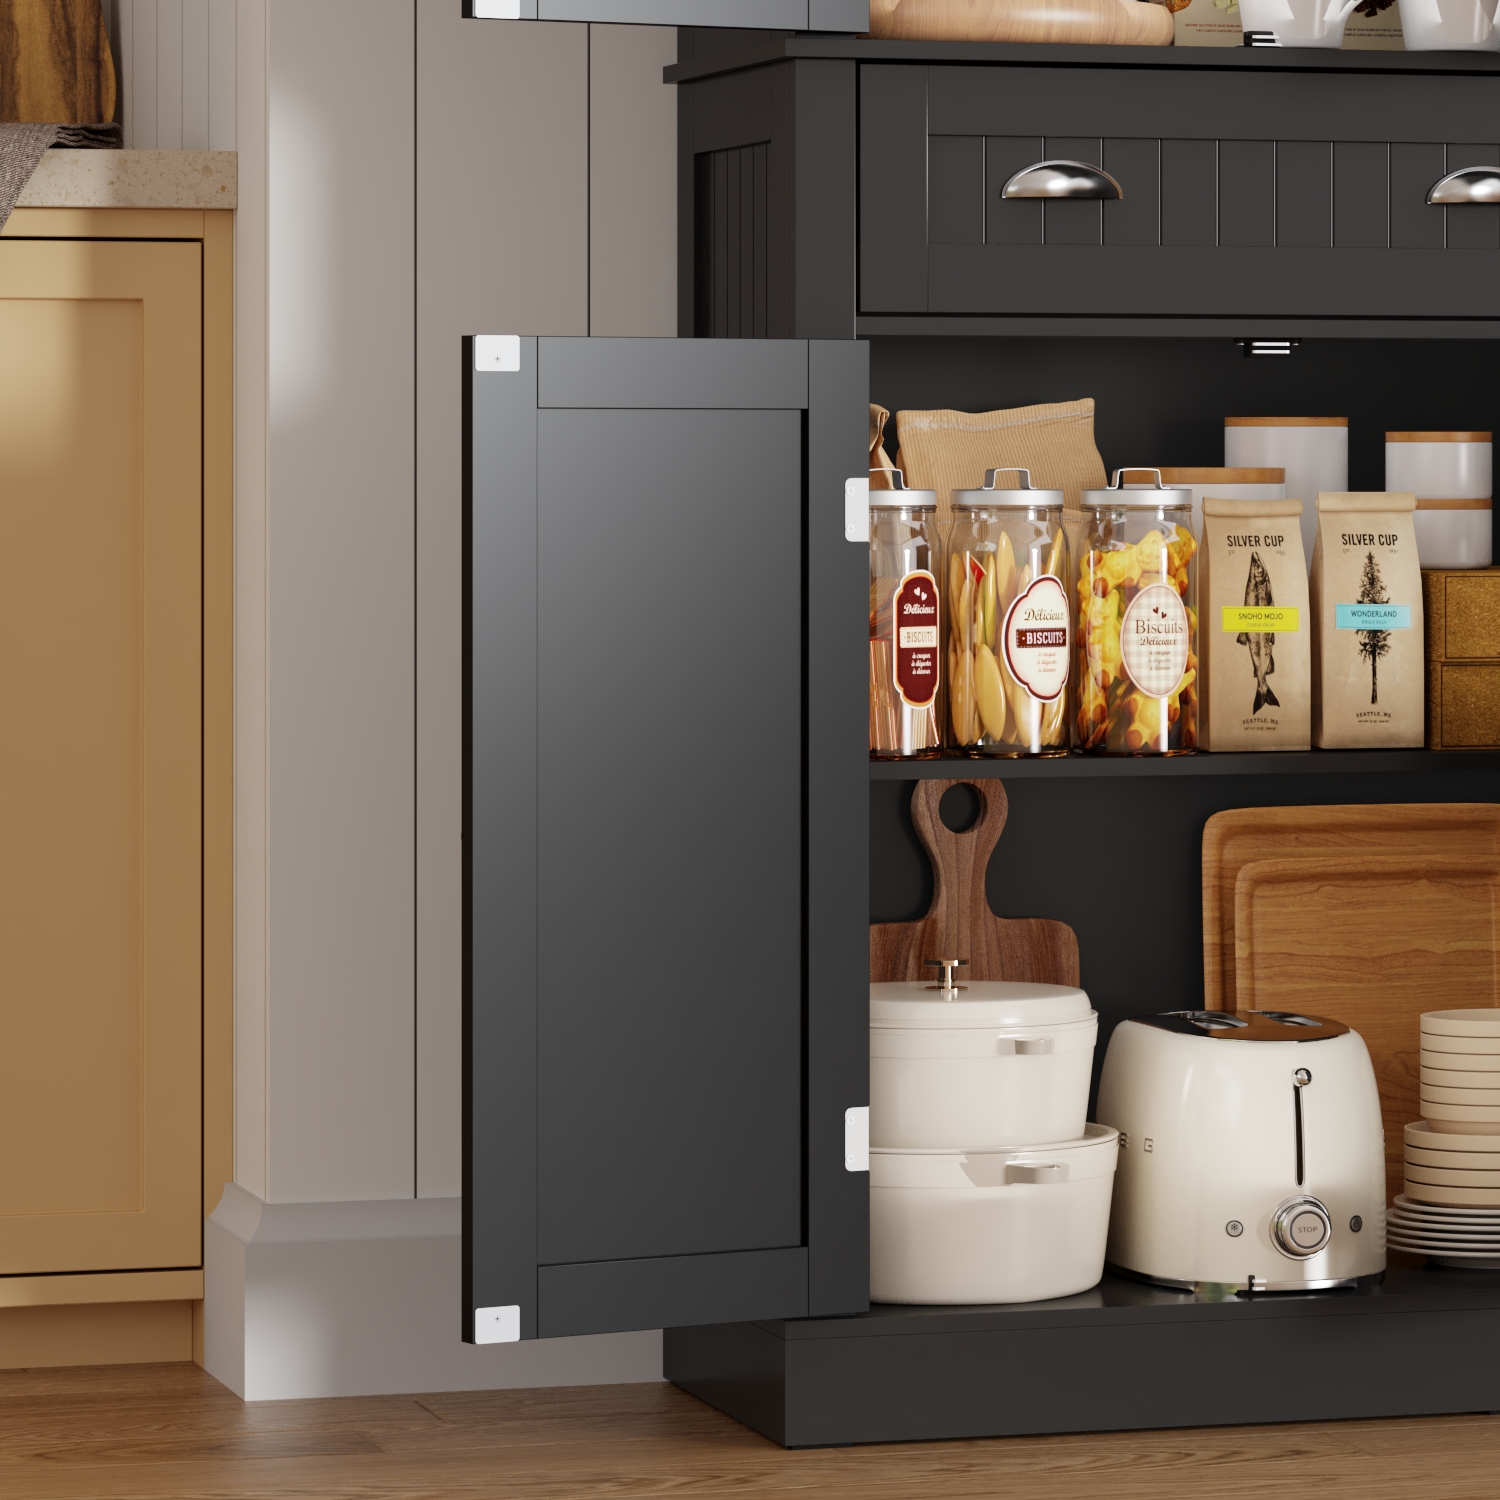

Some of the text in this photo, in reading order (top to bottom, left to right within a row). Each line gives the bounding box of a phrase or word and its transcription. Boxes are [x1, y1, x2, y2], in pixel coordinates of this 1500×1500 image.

[1227, 535, 1284, 547] SILVER CUP
[1341, 533, 1398, 546] SILVER CUP
[903, 603, 935, 615] Délicieux
[1024, 608, 1064, 621] Délicieux
[1350, 610, 1398, 618] WONDERLAND
[1238, 612, 1284, 620] SNOHO MOJO
[1135, 619, 1183, 634] Biscuits
[1140, 636, 1177, 646] Délicieux
